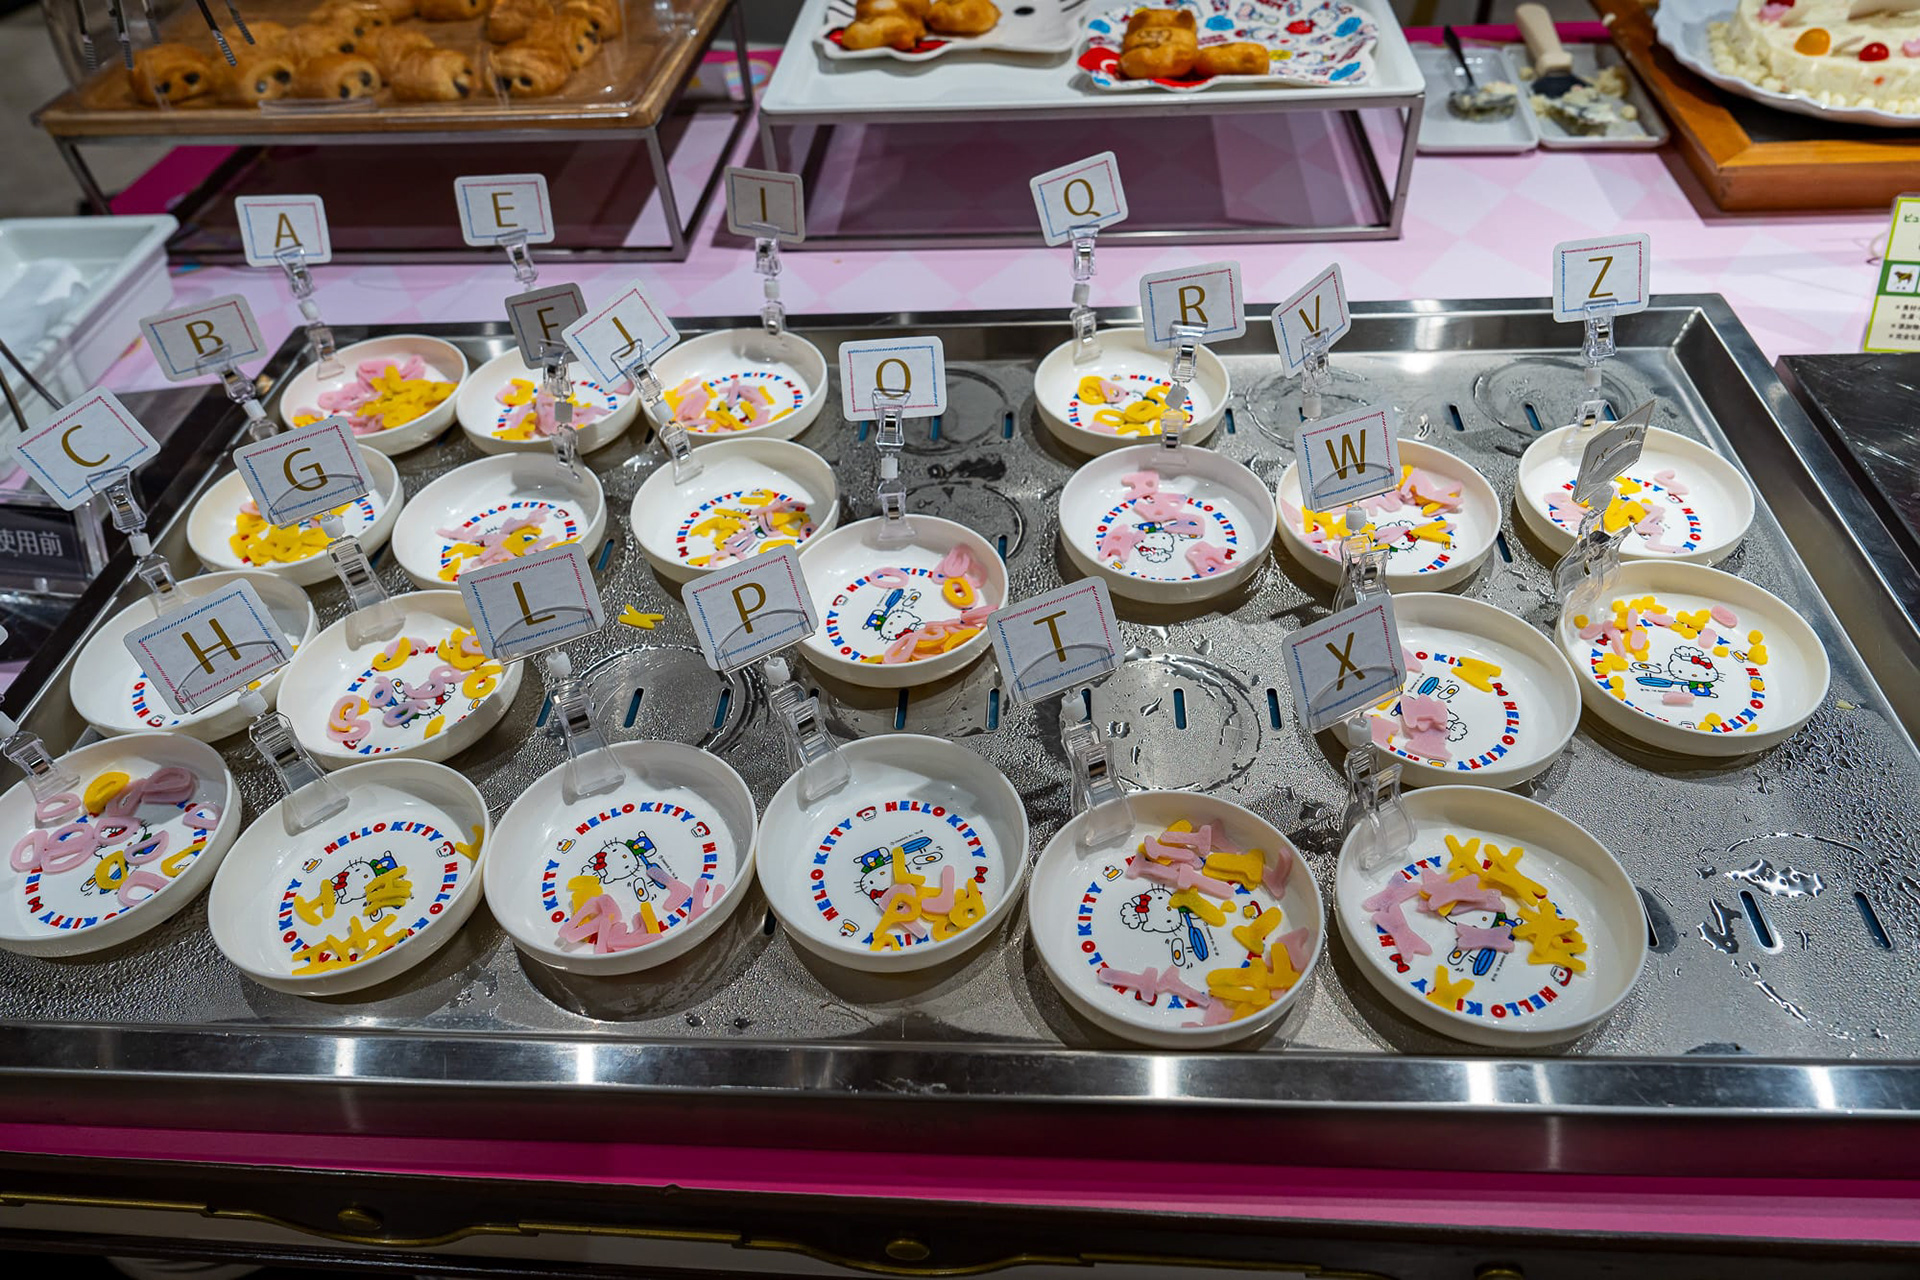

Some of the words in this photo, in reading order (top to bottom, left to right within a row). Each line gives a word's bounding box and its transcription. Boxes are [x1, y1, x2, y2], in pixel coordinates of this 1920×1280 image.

[492, 192, 515, 227] E
[1064, 178, 1100, 217] Q
[275, 213, 299, 248] A
[1588, 256, 1614, 299] Z
[1178, 285, 1208, 326] R
[1298, 295, 1321, 338] V
[185, 320, 223, 354] B
[537, 307, 560, 349] F
[612, 317, 635, 357] J
[876, 358, 911, 398] O
[62, 425, 110, 468] C
[1326, 429, 1366, 480] W
[283, 447, 328, 492] G
[463, 505, 508, 528] HELLO
[676, 511, 700, 543] HELLO
[700, 490, 744, 511] KITTY
[1213, 512, 1238, 545] KITTY
[1681, 507, 1702, 541] HELLO
[512, 581, 556, 626] L
[731, 582, 767, 634] P
[181, 618, 241, 675] H
[826, 610, 845, 647] KITTY
[1033, 610, 1067, 662] T
[1325, 632, 1365, 691] X
[131, 681, 151, 718] HELLO
[1502, 701, 1521, 746] HELLO
[1457, 743, 1508, 772] KITTY
[323, 822, 387, 855] HELLO
[390, 821, 444, 842] KITTY
[574, 803, 636, 836] HELLO
[639, 801, 697, 823] KITTY
[885, 800, 947, 818] HELLO
[946, 813, 987, 859] KITTY
[813, 818, 853, 865] KITTY
[278, 878, 302, 931] KITTY
[428, 861, 459, 915] HELLO
[541, 858, 560, 911] KITTY
[810, 868, 839, 922] HELLO
[38, 911, 99, 930] KITTY
[1077, 881, 1103, 937] KITTY
[1490, 986, 1559, 1019] HELLO
